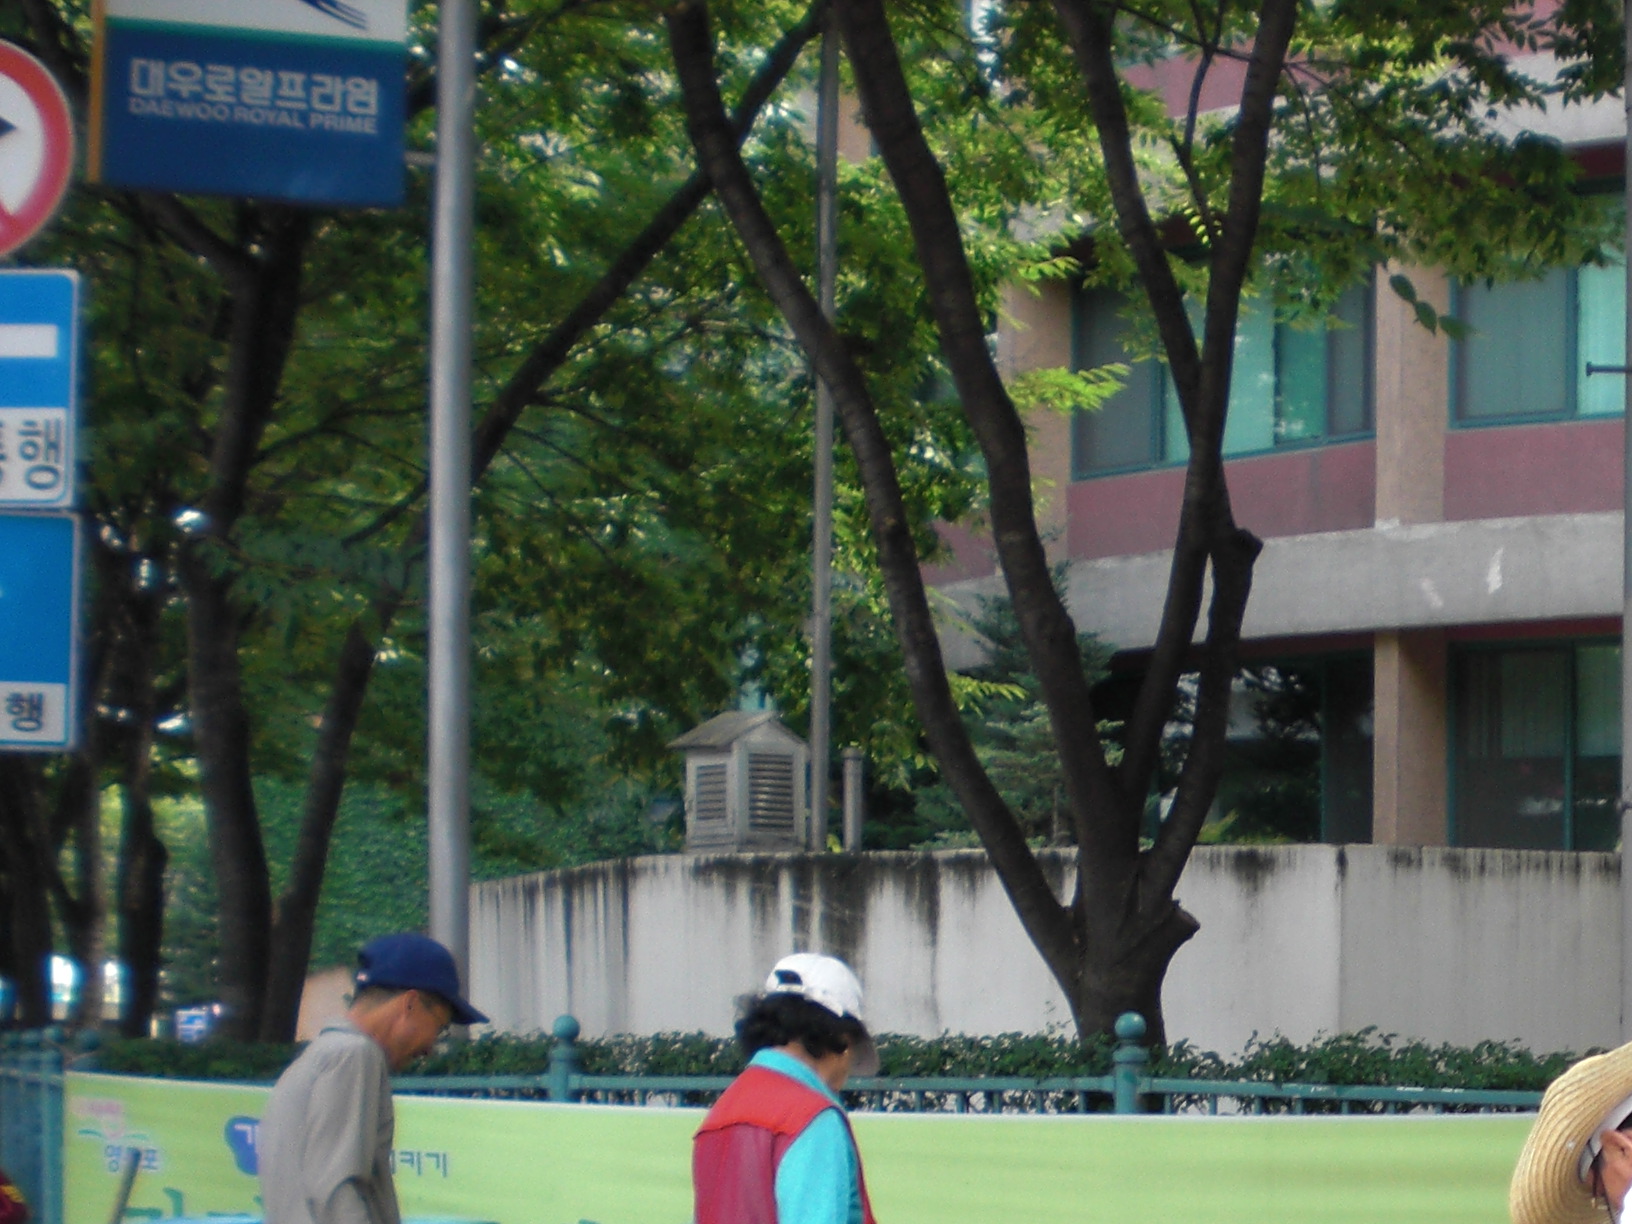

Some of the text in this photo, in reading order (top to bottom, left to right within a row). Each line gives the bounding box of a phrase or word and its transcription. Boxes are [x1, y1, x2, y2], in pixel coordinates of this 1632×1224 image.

[129, 97, 378, 134] DAEWOO ROYAL PRIME
